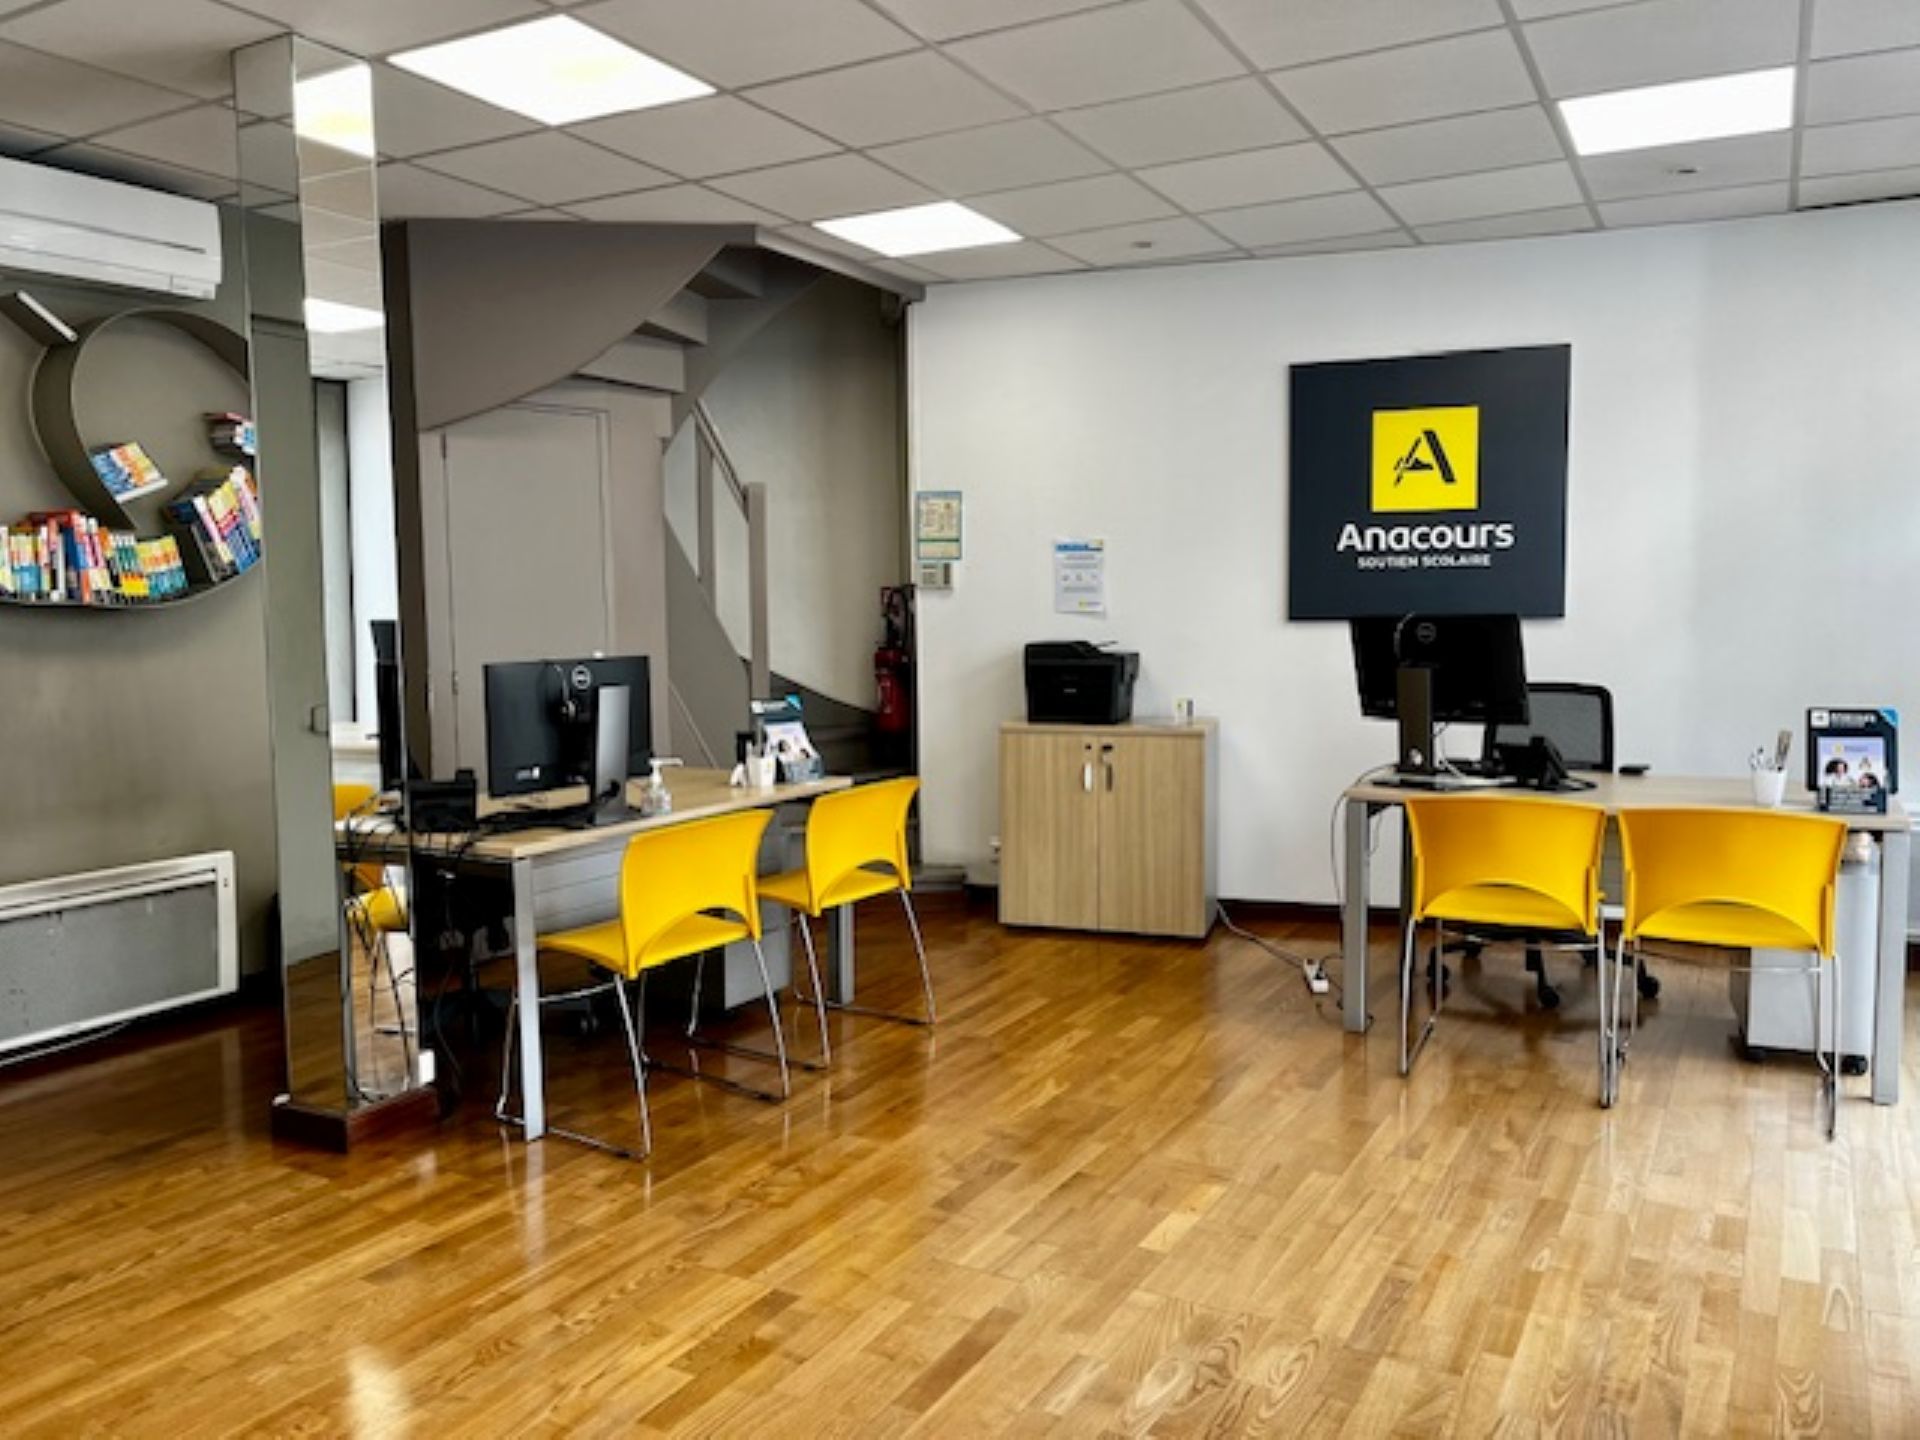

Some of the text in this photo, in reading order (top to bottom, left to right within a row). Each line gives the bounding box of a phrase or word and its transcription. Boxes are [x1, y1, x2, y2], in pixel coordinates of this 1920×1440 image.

[1336, 523, 1515, 551] Anacours
[1357, 553, 1492, 569] SOUTIEN SCOLAIRE
